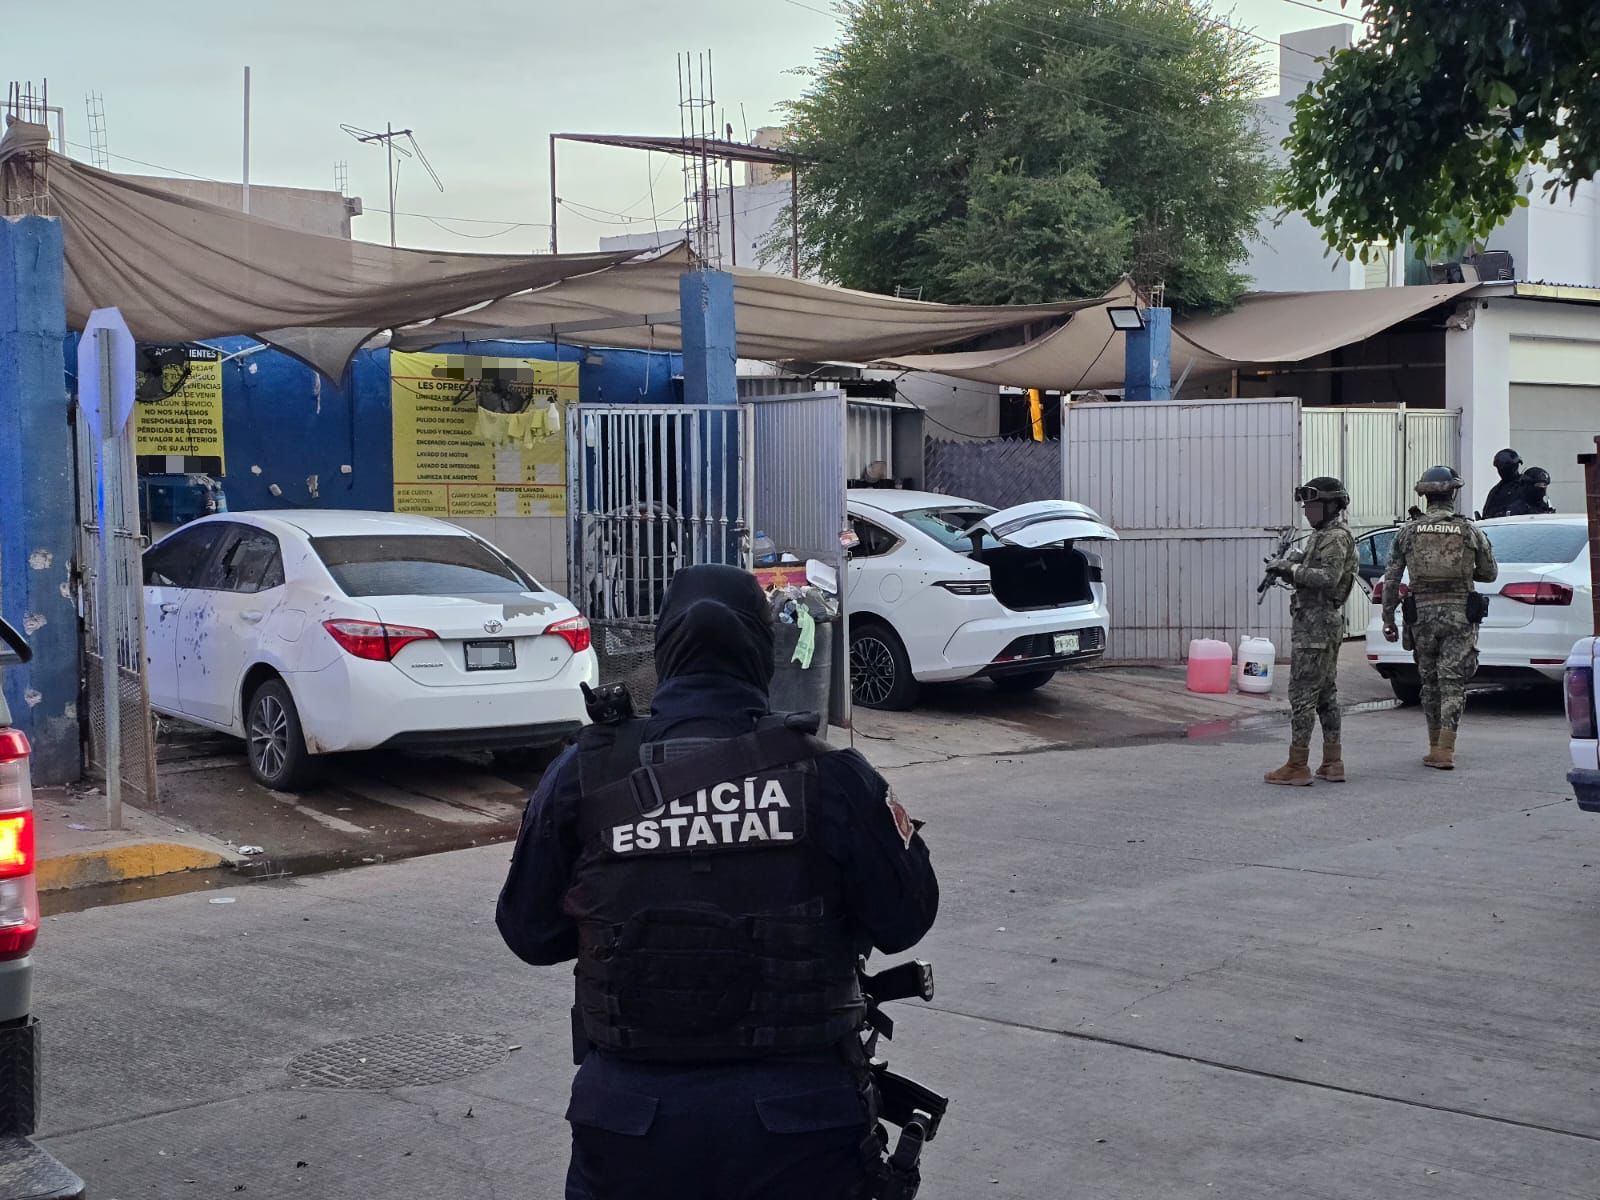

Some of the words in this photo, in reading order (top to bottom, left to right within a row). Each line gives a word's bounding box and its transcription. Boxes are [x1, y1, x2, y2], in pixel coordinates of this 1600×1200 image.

[417, 382, 434, 390] LES
[137, 425, 174, 434] PÉRDIDAS
[1416, 524, 1461, 534] MARINA
[641, 776, 791, 819] LICÍA
[612, 810, 794, 853] ESTATAL
